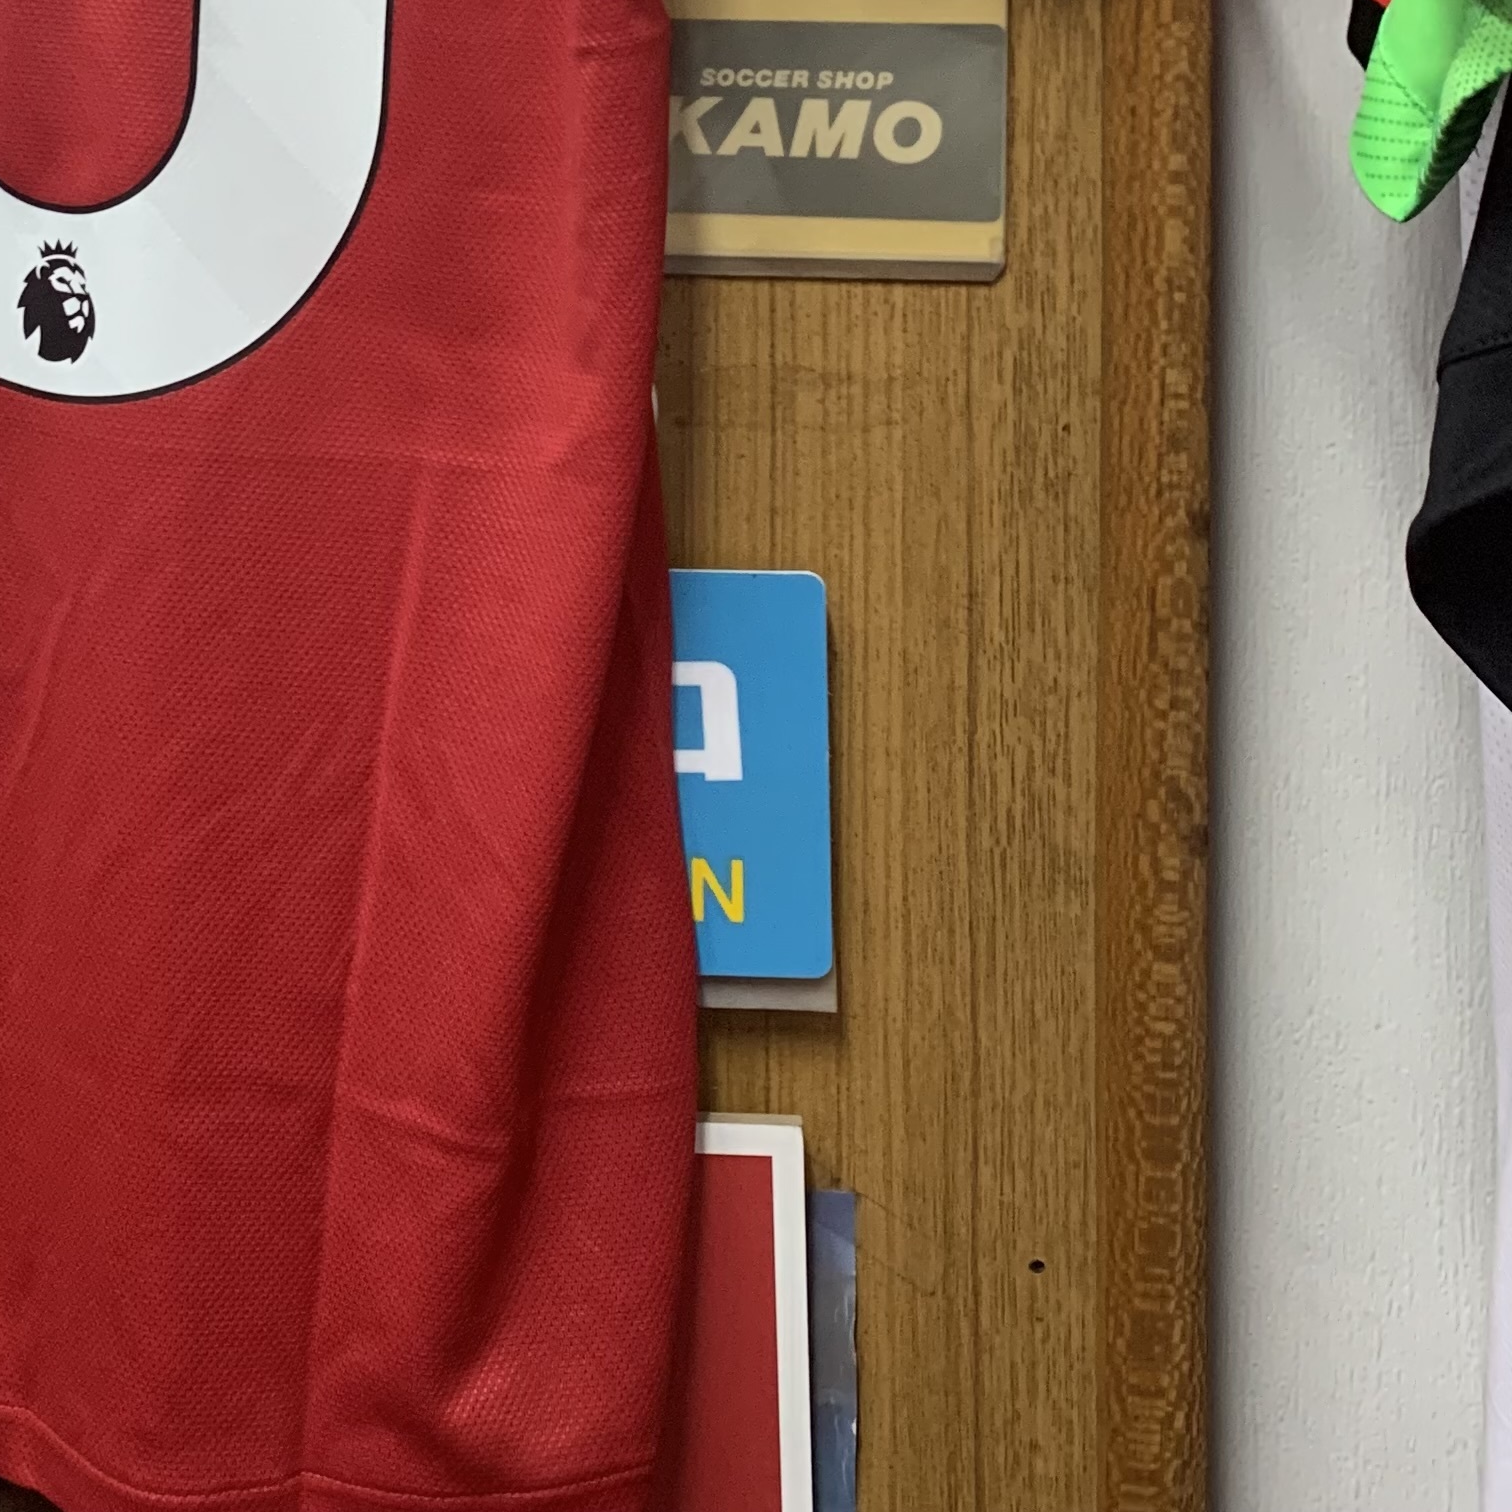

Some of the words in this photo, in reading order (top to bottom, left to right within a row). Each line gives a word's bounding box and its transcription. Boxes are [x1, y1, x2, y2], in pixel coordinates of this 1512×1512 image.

[699, 67, 809, 88] SOCCER
[816, 70, 894, 90] SHOP
[669, 95, 943, 165] KAMO
